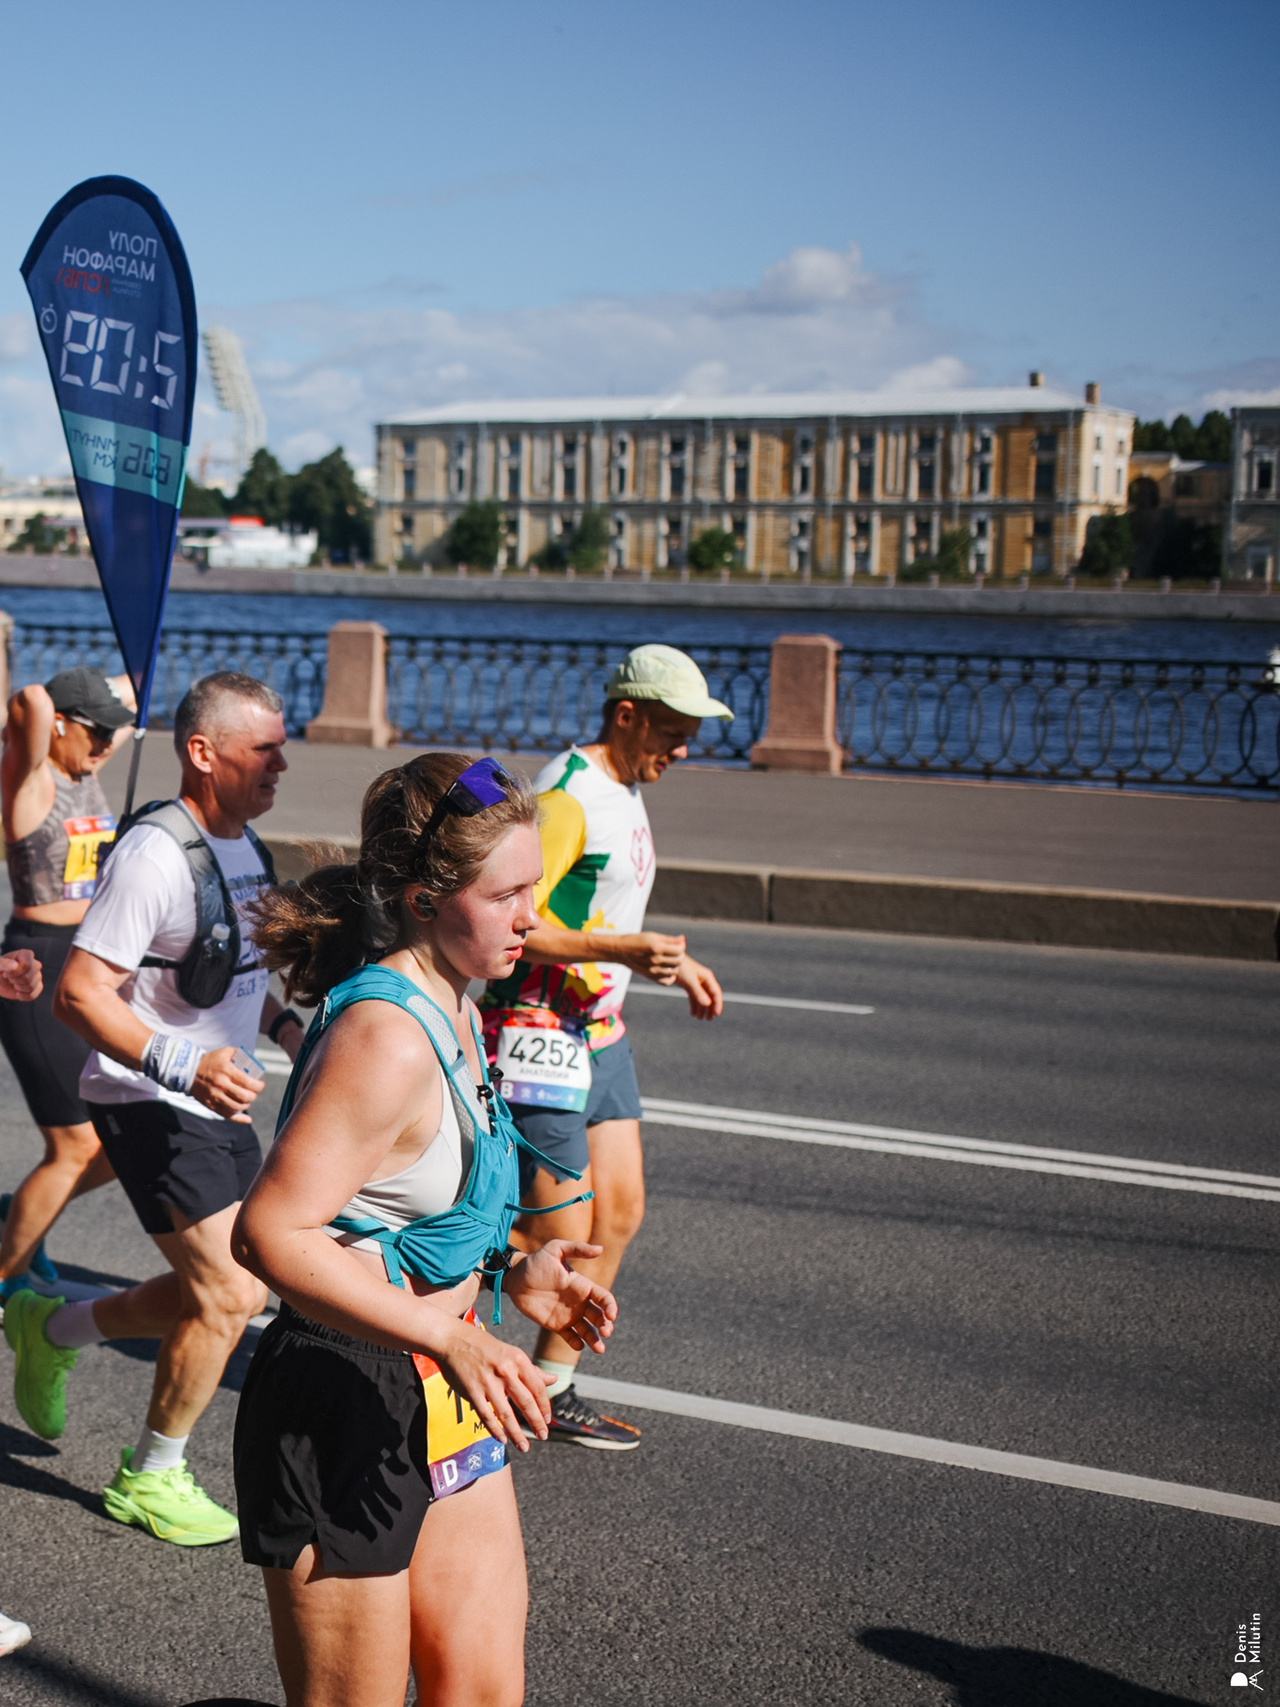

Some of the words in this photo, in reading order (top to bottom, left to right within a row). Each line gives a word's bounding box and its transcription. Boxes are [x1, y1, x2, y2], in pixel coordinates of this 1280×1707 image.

[509, 1036, 580, 1070] 4252
[519, 1067, 570, 1079] АНАТОЛИЙ
[441, 1458, 459, 1487] D
